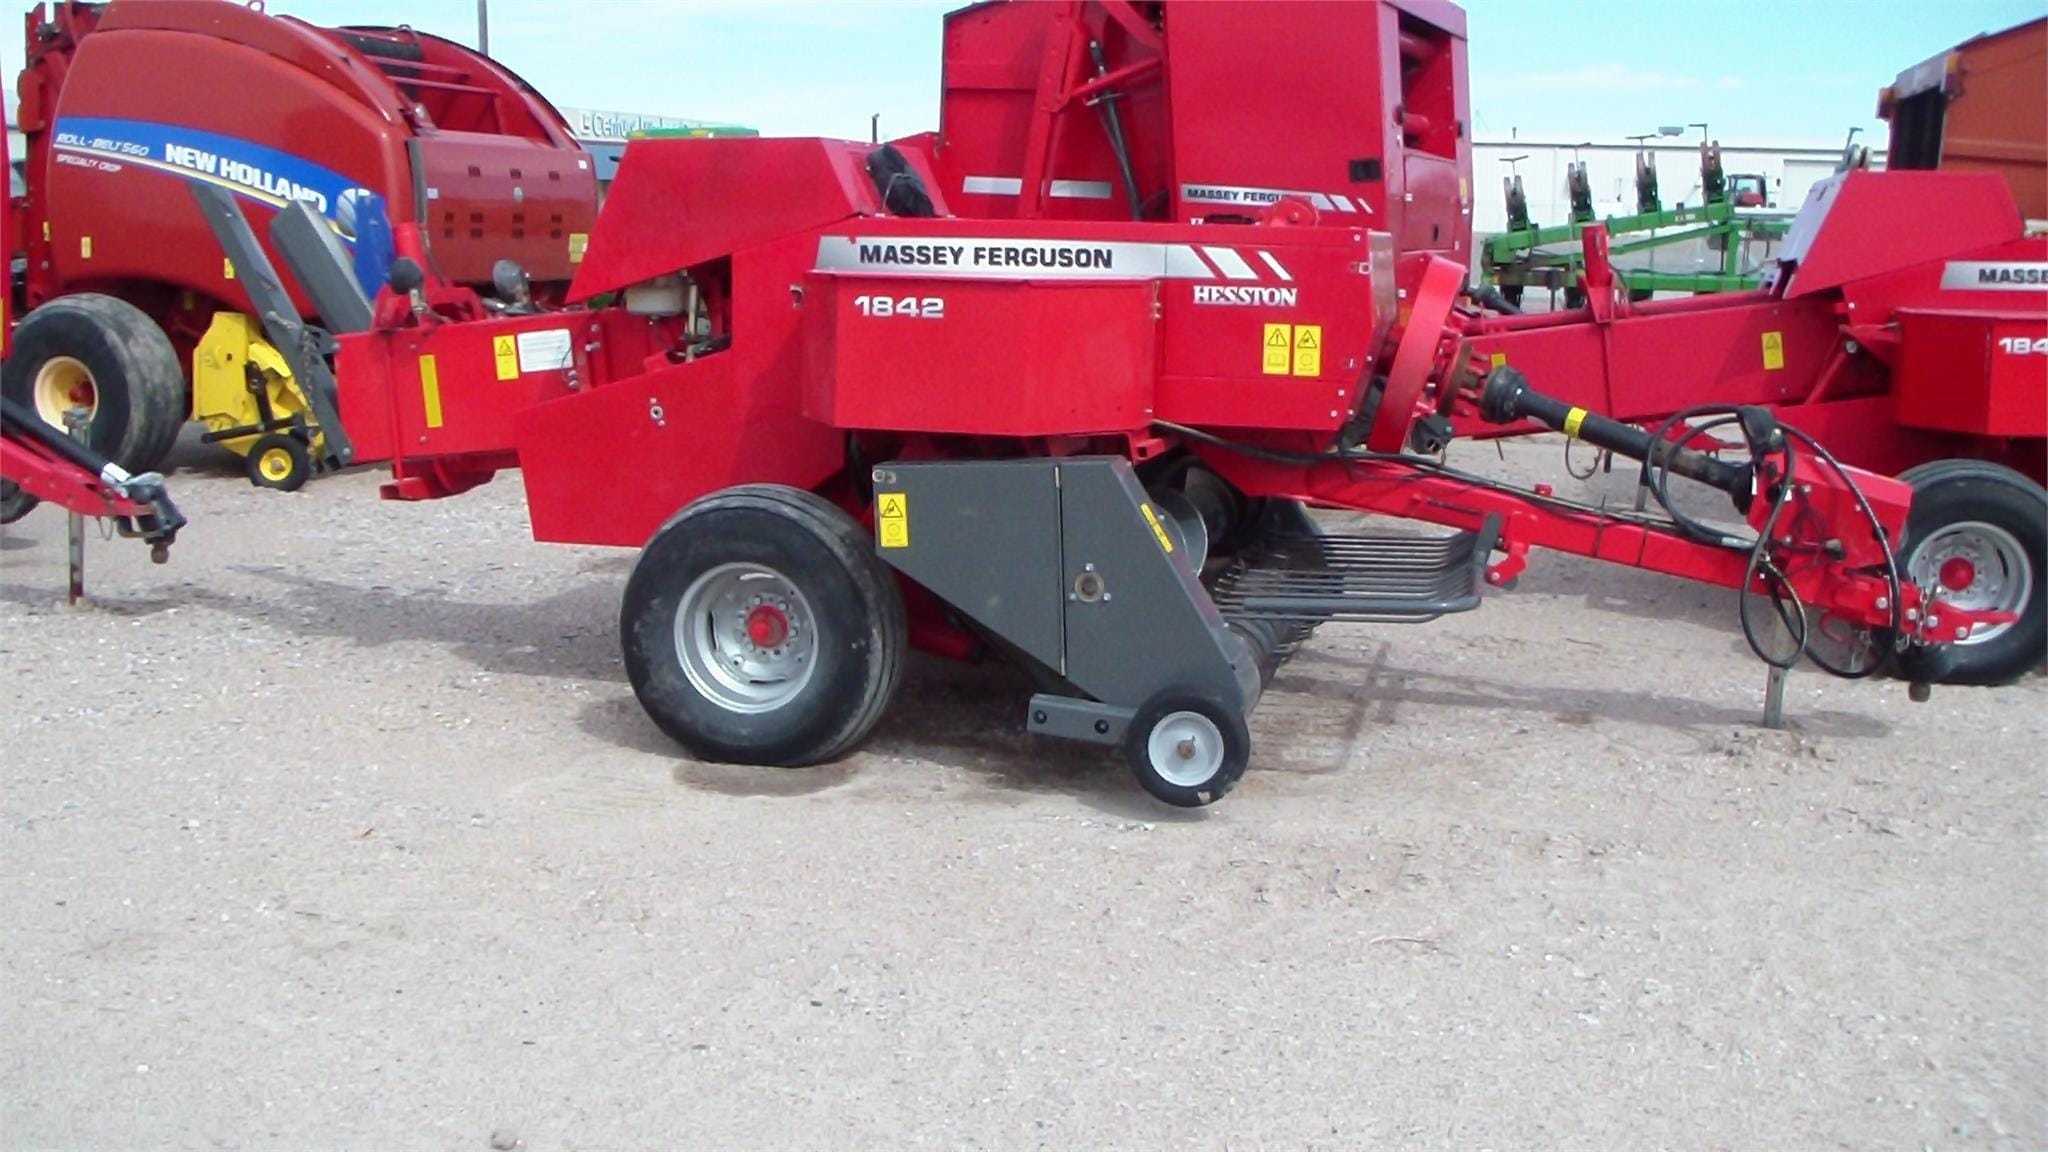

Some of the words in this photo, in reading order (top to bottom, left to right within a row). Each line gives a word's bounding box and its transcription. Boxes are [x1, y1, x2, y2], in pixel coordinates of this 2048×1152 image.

[121, 142, 150, 156] 560
[165, 143, 216, 173] NEW
[219, 158, 326, 213] HOLLAND
[1187, 188, 1239, 200] MASSEY
[859, 245, 964, 266] MASSEY
[973, 246, 1113, 269] FERGUSON
[854, 295, 945, 319] 1842
[1193, 285, 1297, 307] HESSTON
